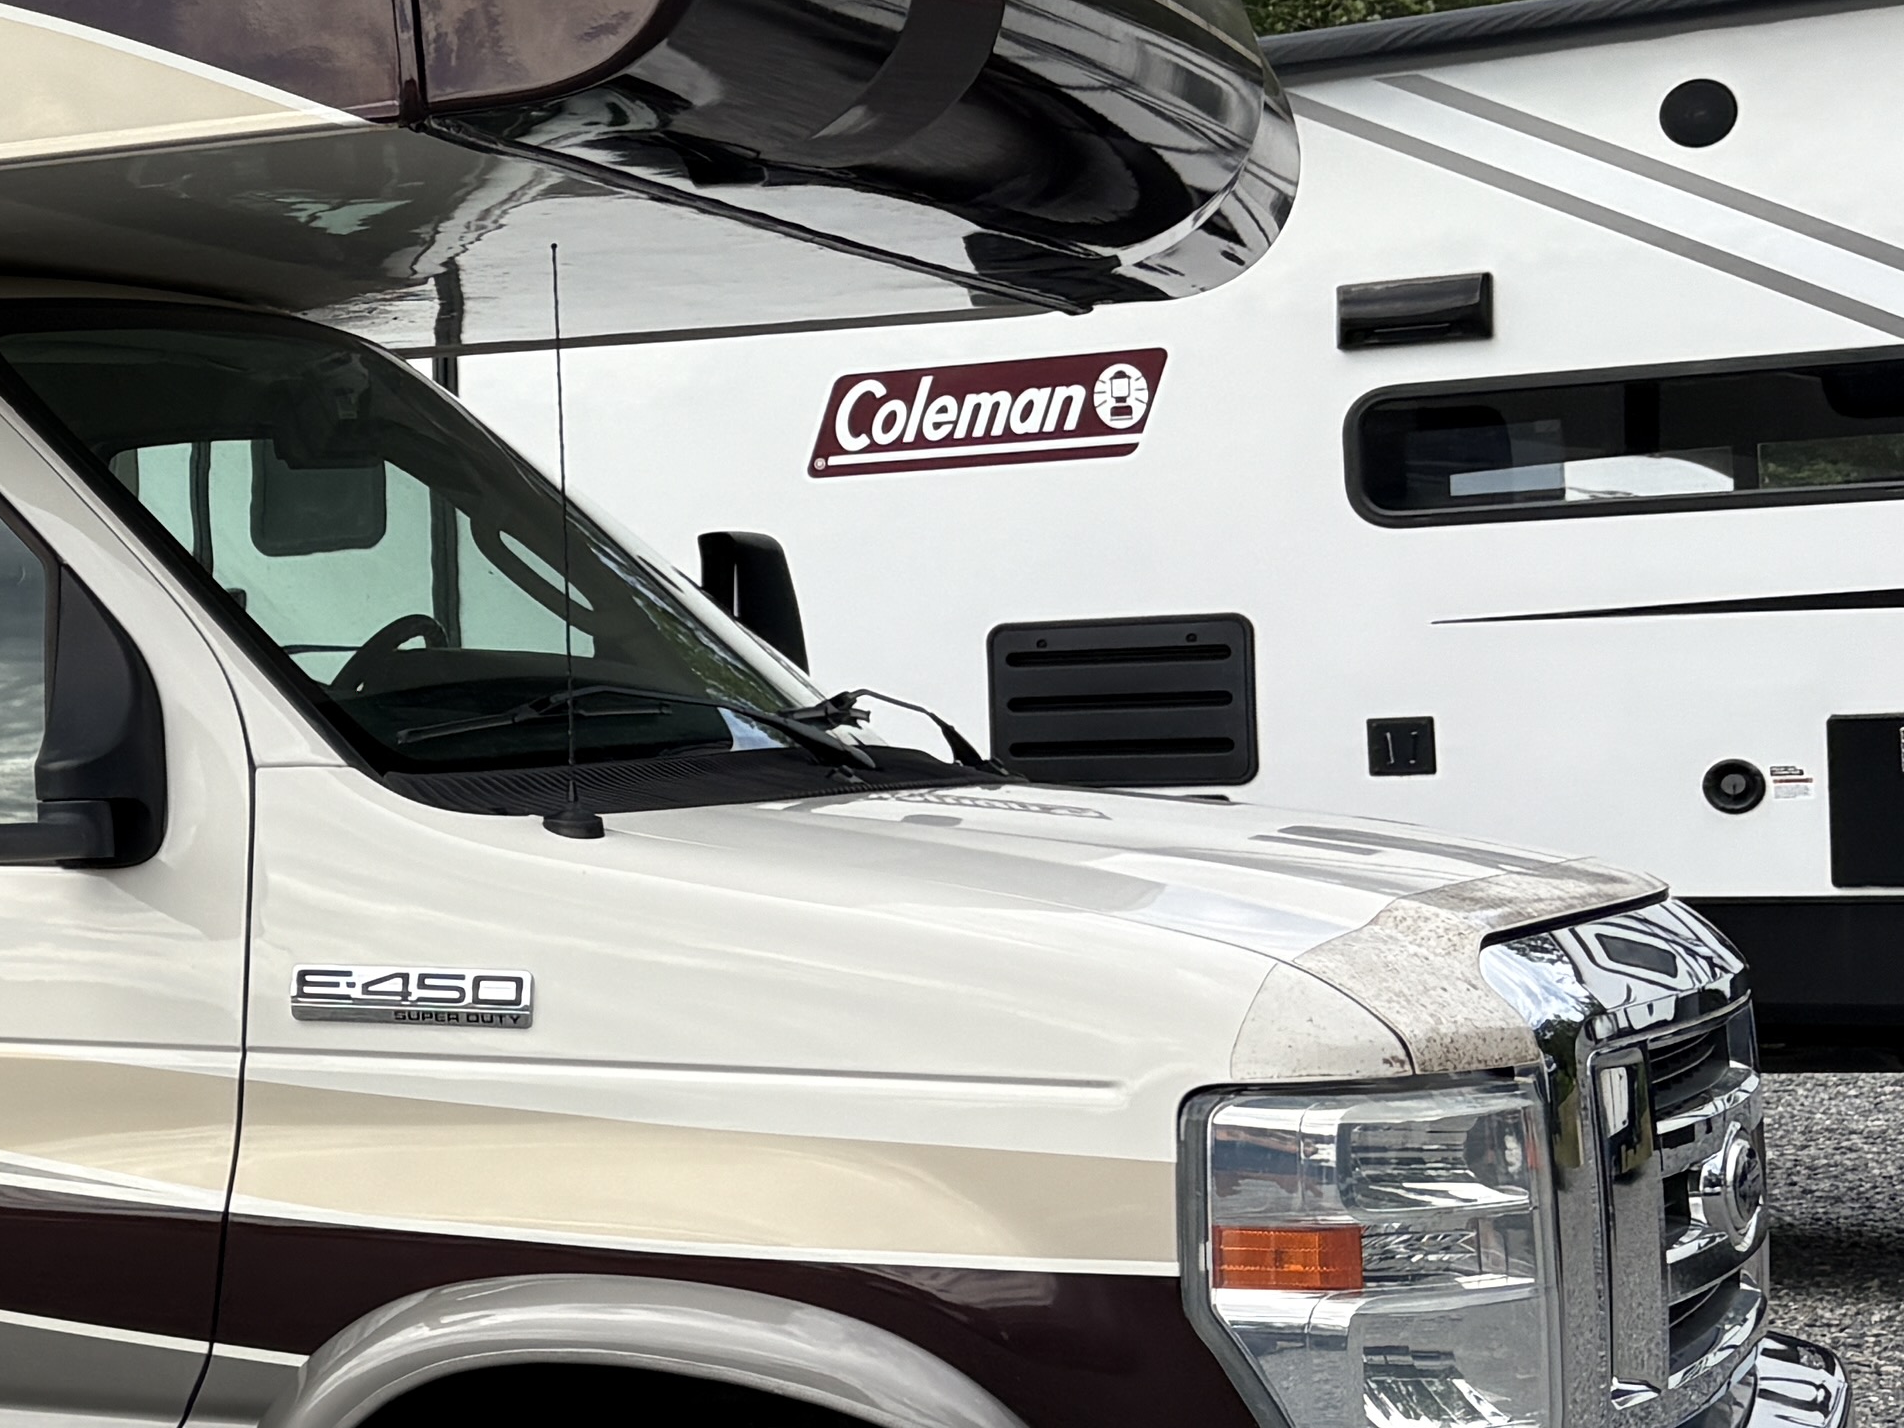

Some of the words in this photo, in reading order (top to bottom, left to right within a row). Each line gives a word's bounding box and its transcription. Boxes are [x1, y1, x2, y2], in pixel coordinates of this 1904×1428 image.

[835, 375, 1087, 452] Coleman
[296, 968, 524, 1006] E-450
[394, 1010, 459, 1024] SUPER
[466, 1012, 522, 1026] DUTY
